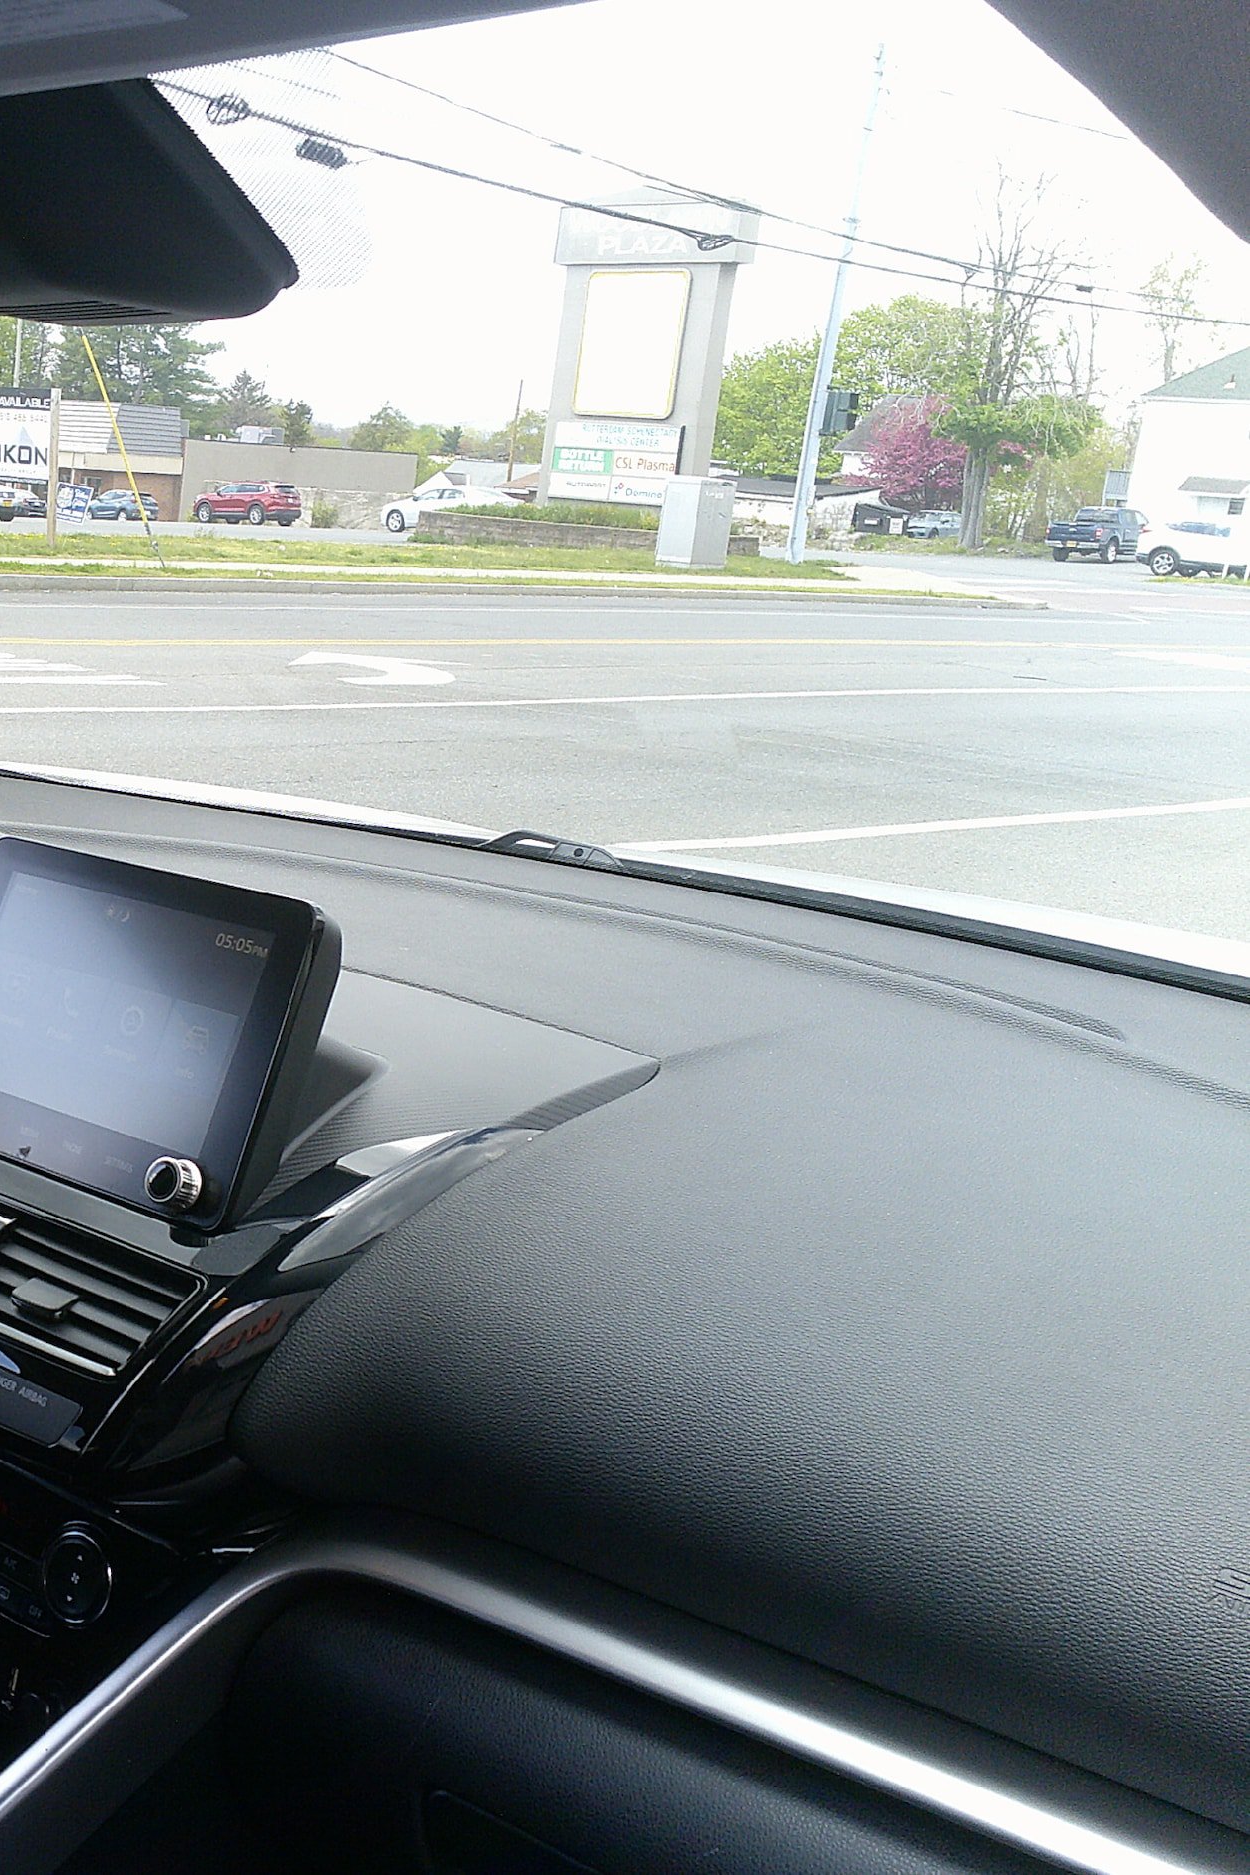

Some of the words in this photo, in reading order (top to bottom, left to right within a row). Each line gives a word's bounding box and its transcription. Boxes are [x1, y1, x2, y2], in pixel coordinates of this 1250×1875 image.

[597, 233, 688, 255] PLAZA
[630, 437, 661, 448] CENTER
[614, 456, 633, 470] CSL
[636, 458, 676, 473] Plasma
[625, 487, 663, 499] Domino
[17, 1386, 48, 1408] AIRBAG
